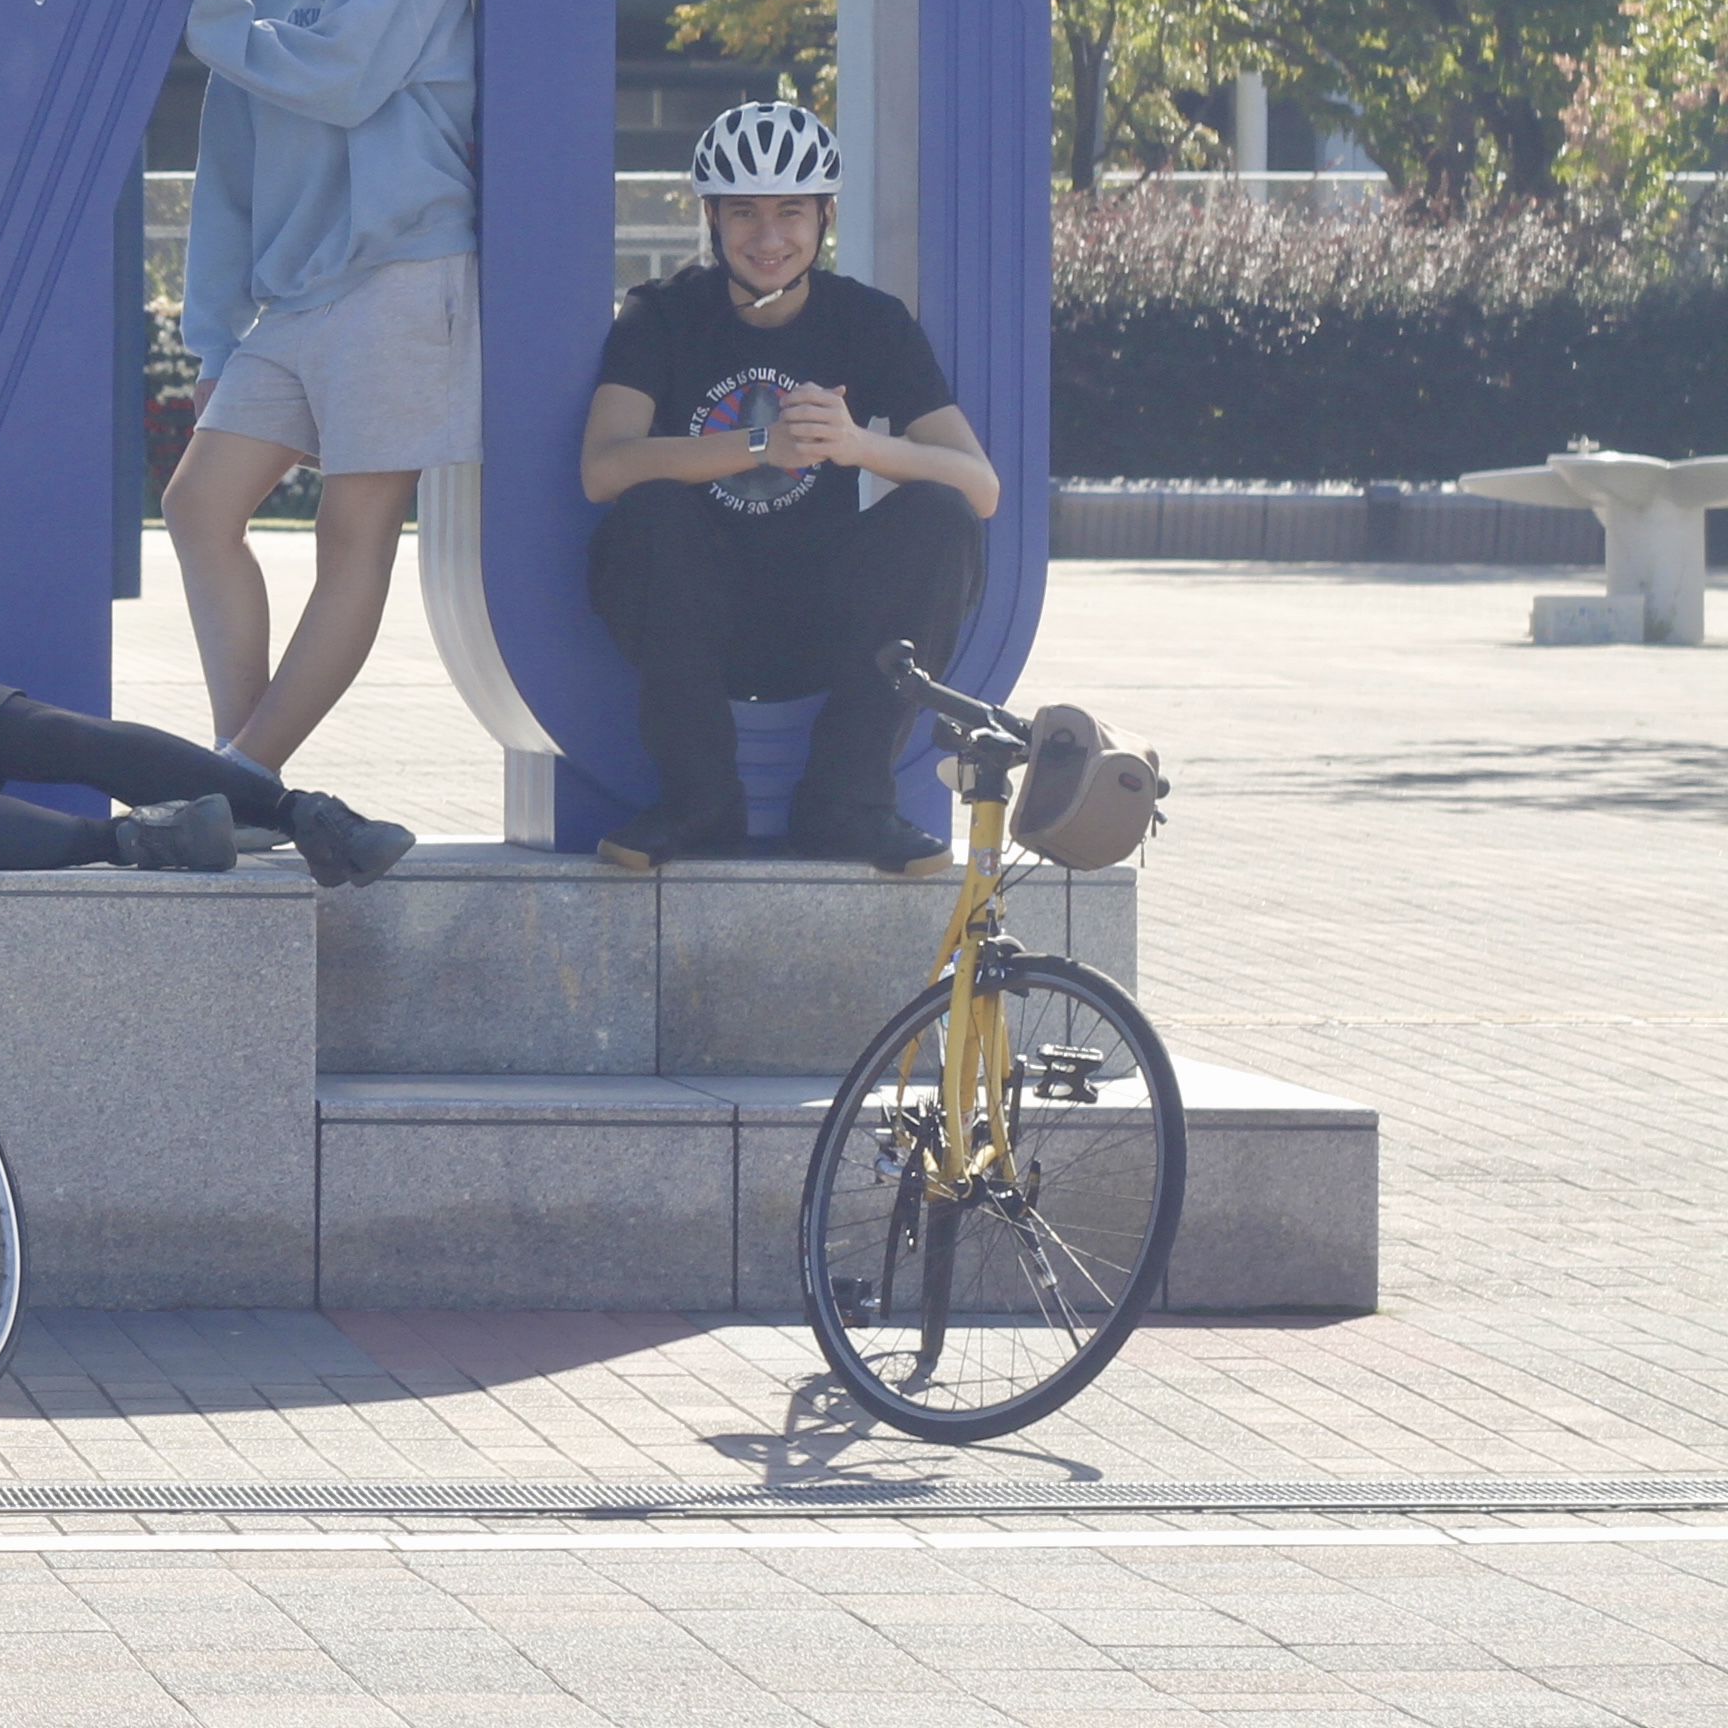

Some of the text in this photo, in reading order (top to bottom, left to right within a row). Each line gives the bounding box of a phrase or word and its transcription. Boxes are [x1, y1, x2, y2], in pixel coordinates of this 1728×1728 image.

[736, 370, 748, 385] IS
[747, 367, 777, 382] OUR
[706, 376, 737, 402] THIS
[709, 481, 745, 511] HEAL
[773, 474, 816, 510] WHERE
[747, 501, 770, 515] WE
